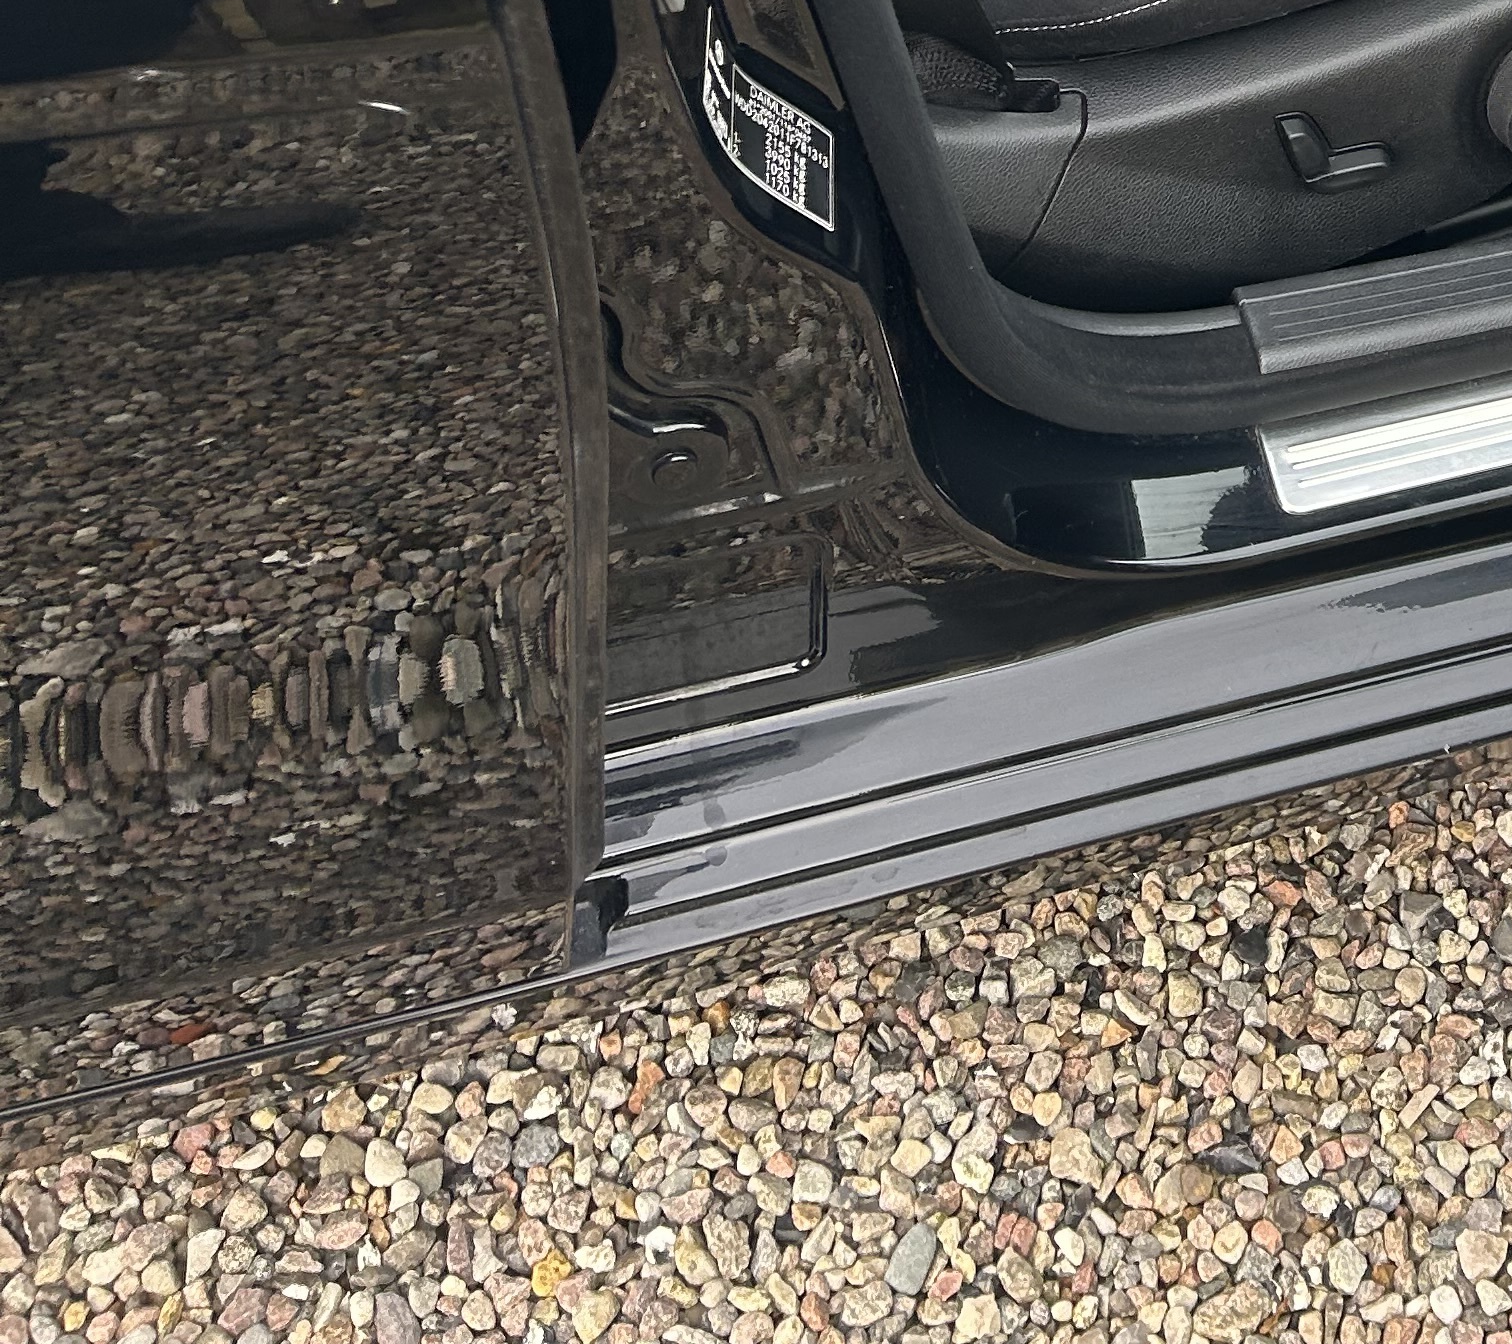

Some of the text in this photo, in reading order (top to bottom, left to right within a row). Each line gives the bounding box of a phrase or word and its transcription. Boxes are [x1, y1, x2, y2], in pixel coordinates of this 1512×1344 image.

[749, 85, 811, 135] DAIMLER AG
[765, 133, 807, 171] 2155 kg
[765, 159, 791, 184] 1025
[793, 178, 806, 196] kg
[765, 172, 791, 197] 1170
[793, 164, 806, 183] kg
